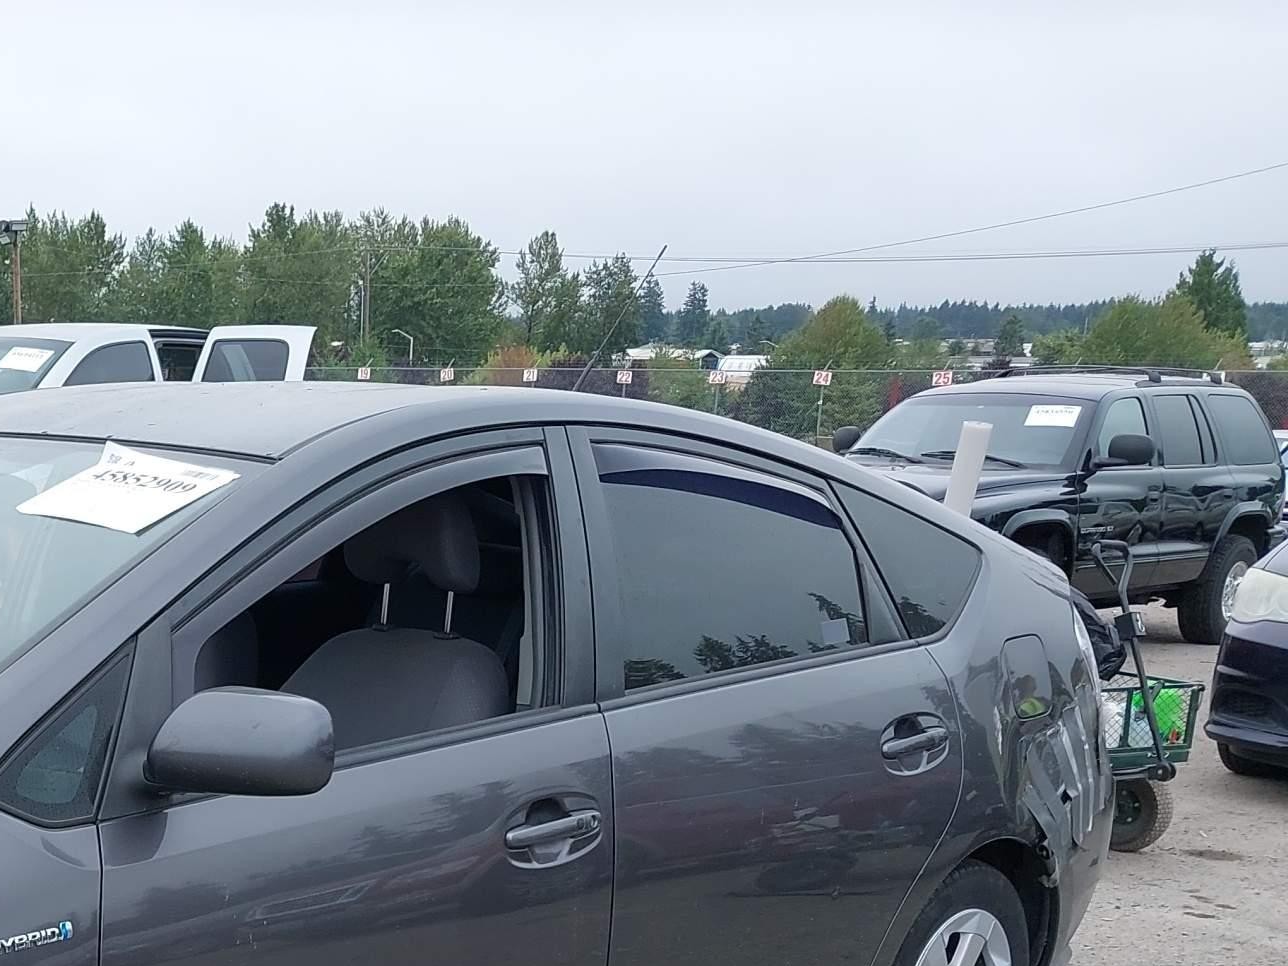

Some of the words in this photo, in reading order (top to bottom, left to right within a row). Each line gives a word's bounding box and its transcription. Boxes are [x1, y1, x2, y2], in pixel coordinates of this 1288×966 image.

[441, 369, 453, 381] 20
[525, 369, 536, 381] 21
[618, 371, 631, 383] 22
[711, 371, 725, 383] 23
[814, 372, 830, 384] 24
[934, 372, 951, 385] 25
[93, 469, 198, 494] 45852909
